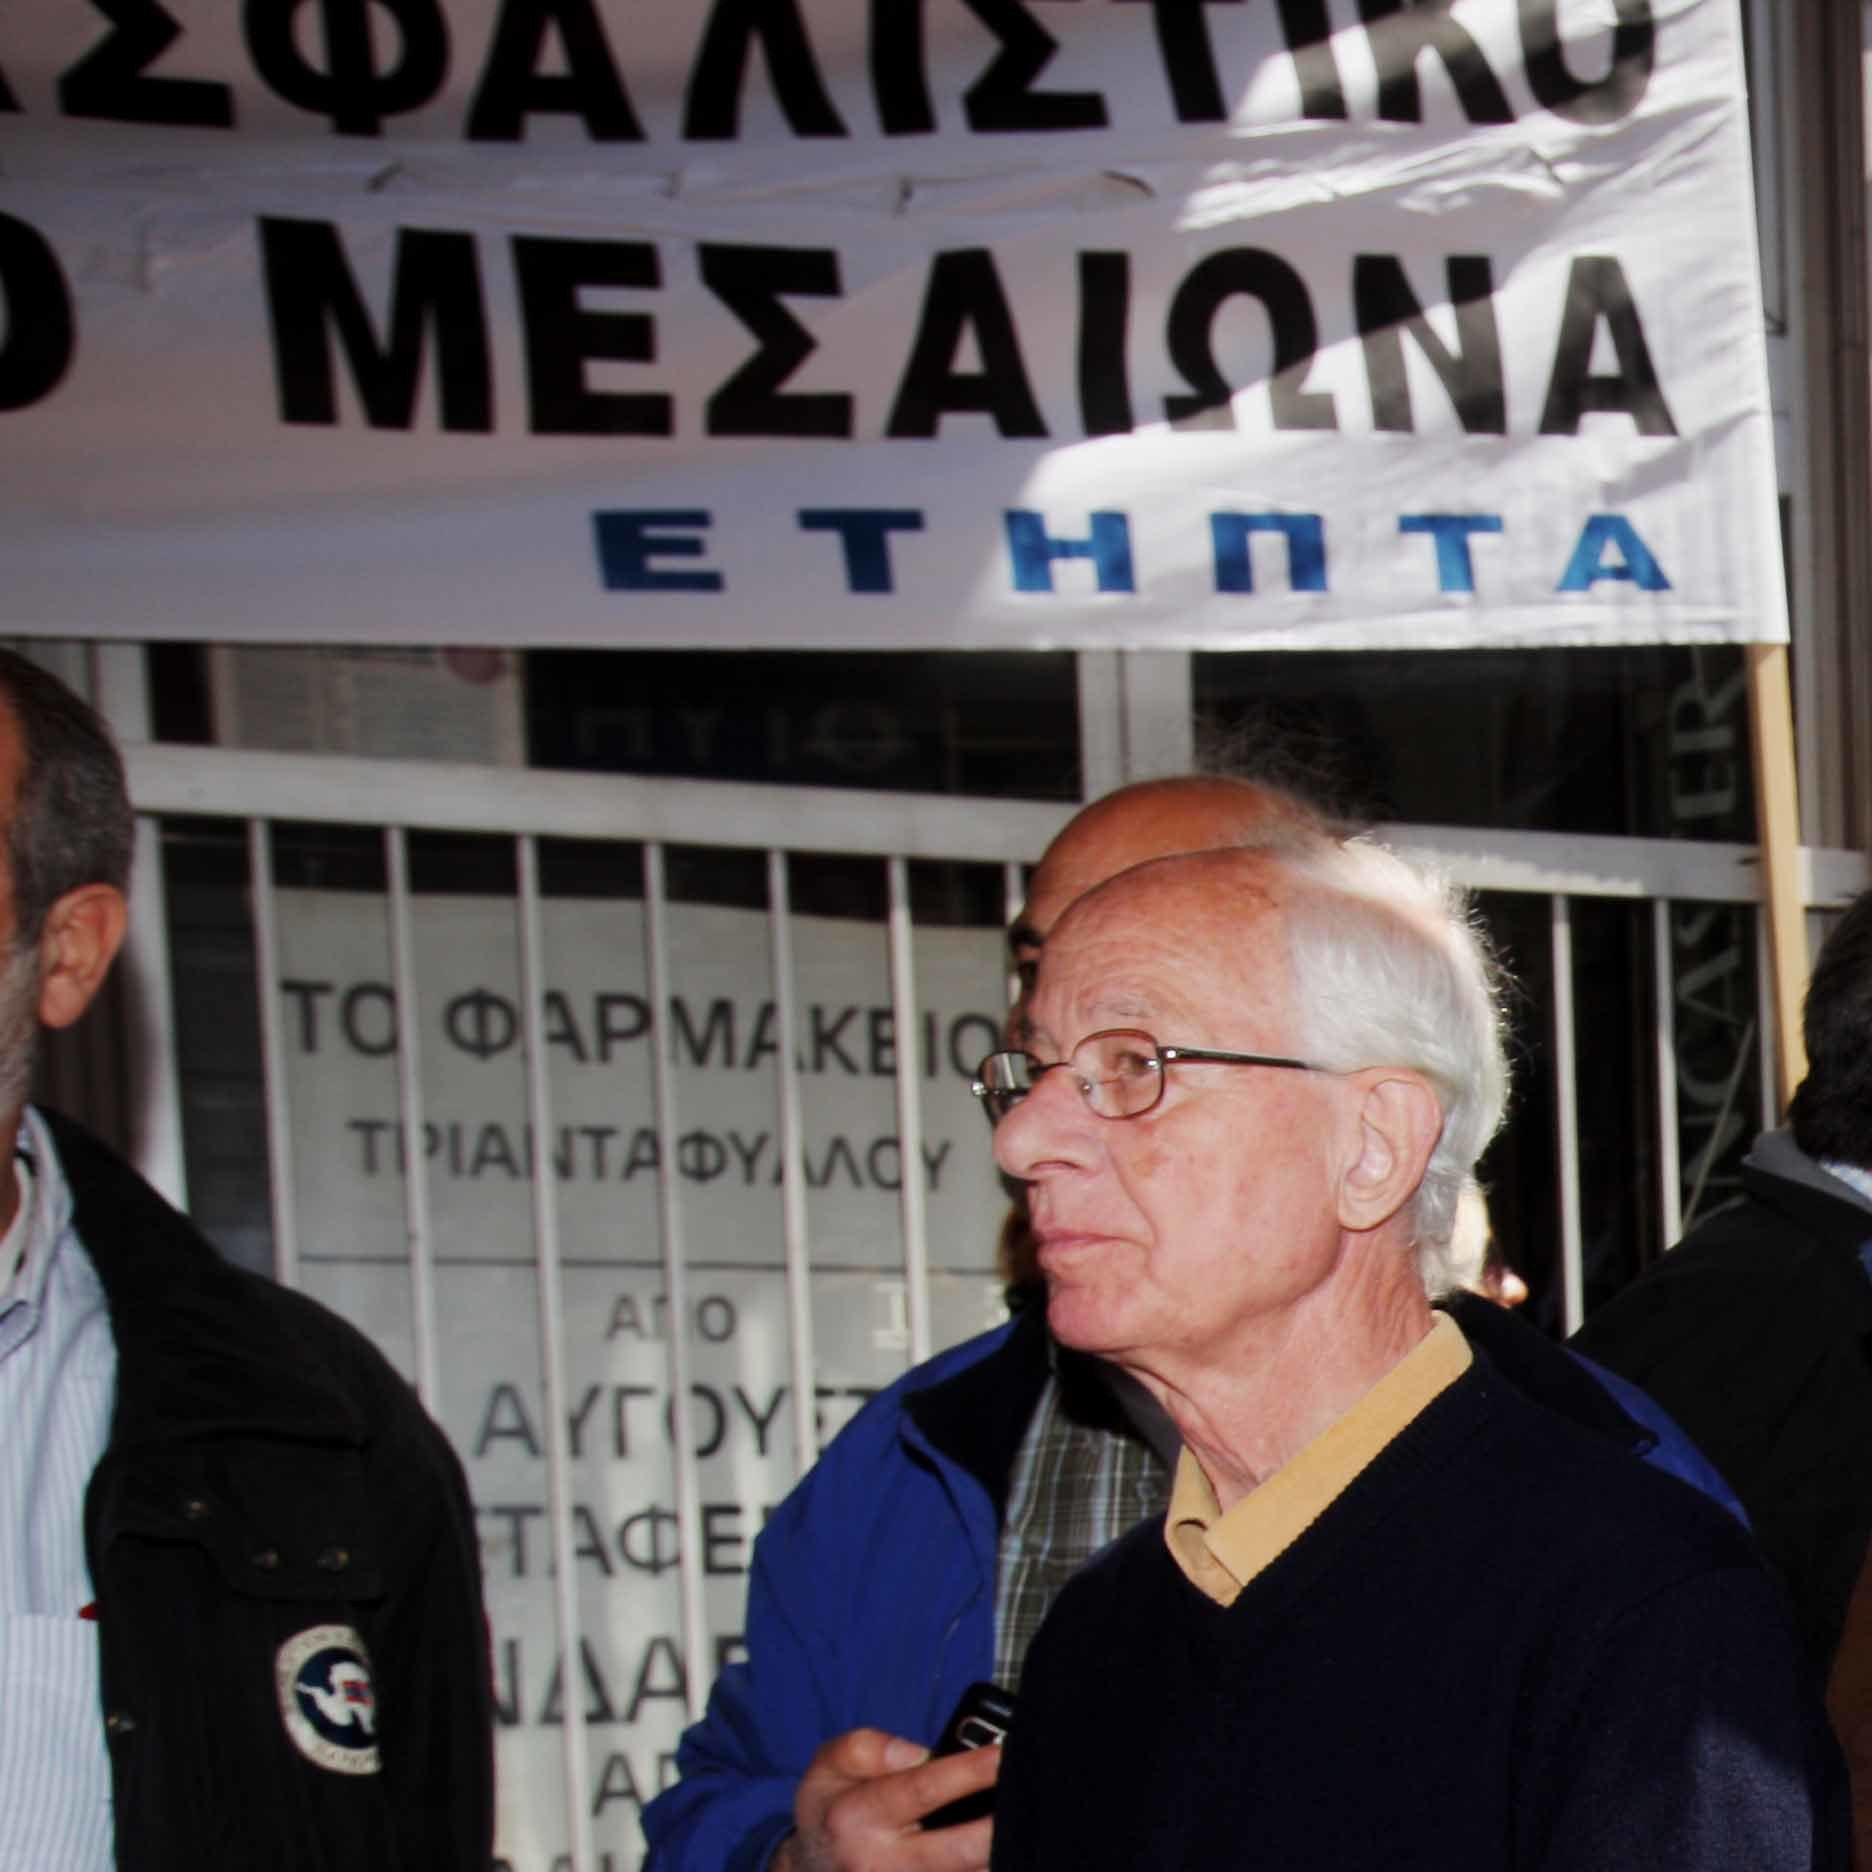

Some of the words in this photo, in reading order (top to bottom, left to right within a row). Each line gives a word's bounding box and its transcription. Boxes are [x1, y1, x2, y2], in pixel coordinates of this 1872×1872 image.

[0, 0, 1656, 142] ΣΦΑΛΙΣΤΙΚΟ
[256, 214, 1678, 438] ΜΕΣΑΙΩΝΑ
[593, 509, 1673, 594] ΕΤΗΠΤΑ
[279, 978, 400, 1057] ΤΟ
[443, 987, 1001, 1079] ΦΑΡΜΑΚΕΙΟ
[474, 1503, 773, 1578] ΤΑΦΕ
